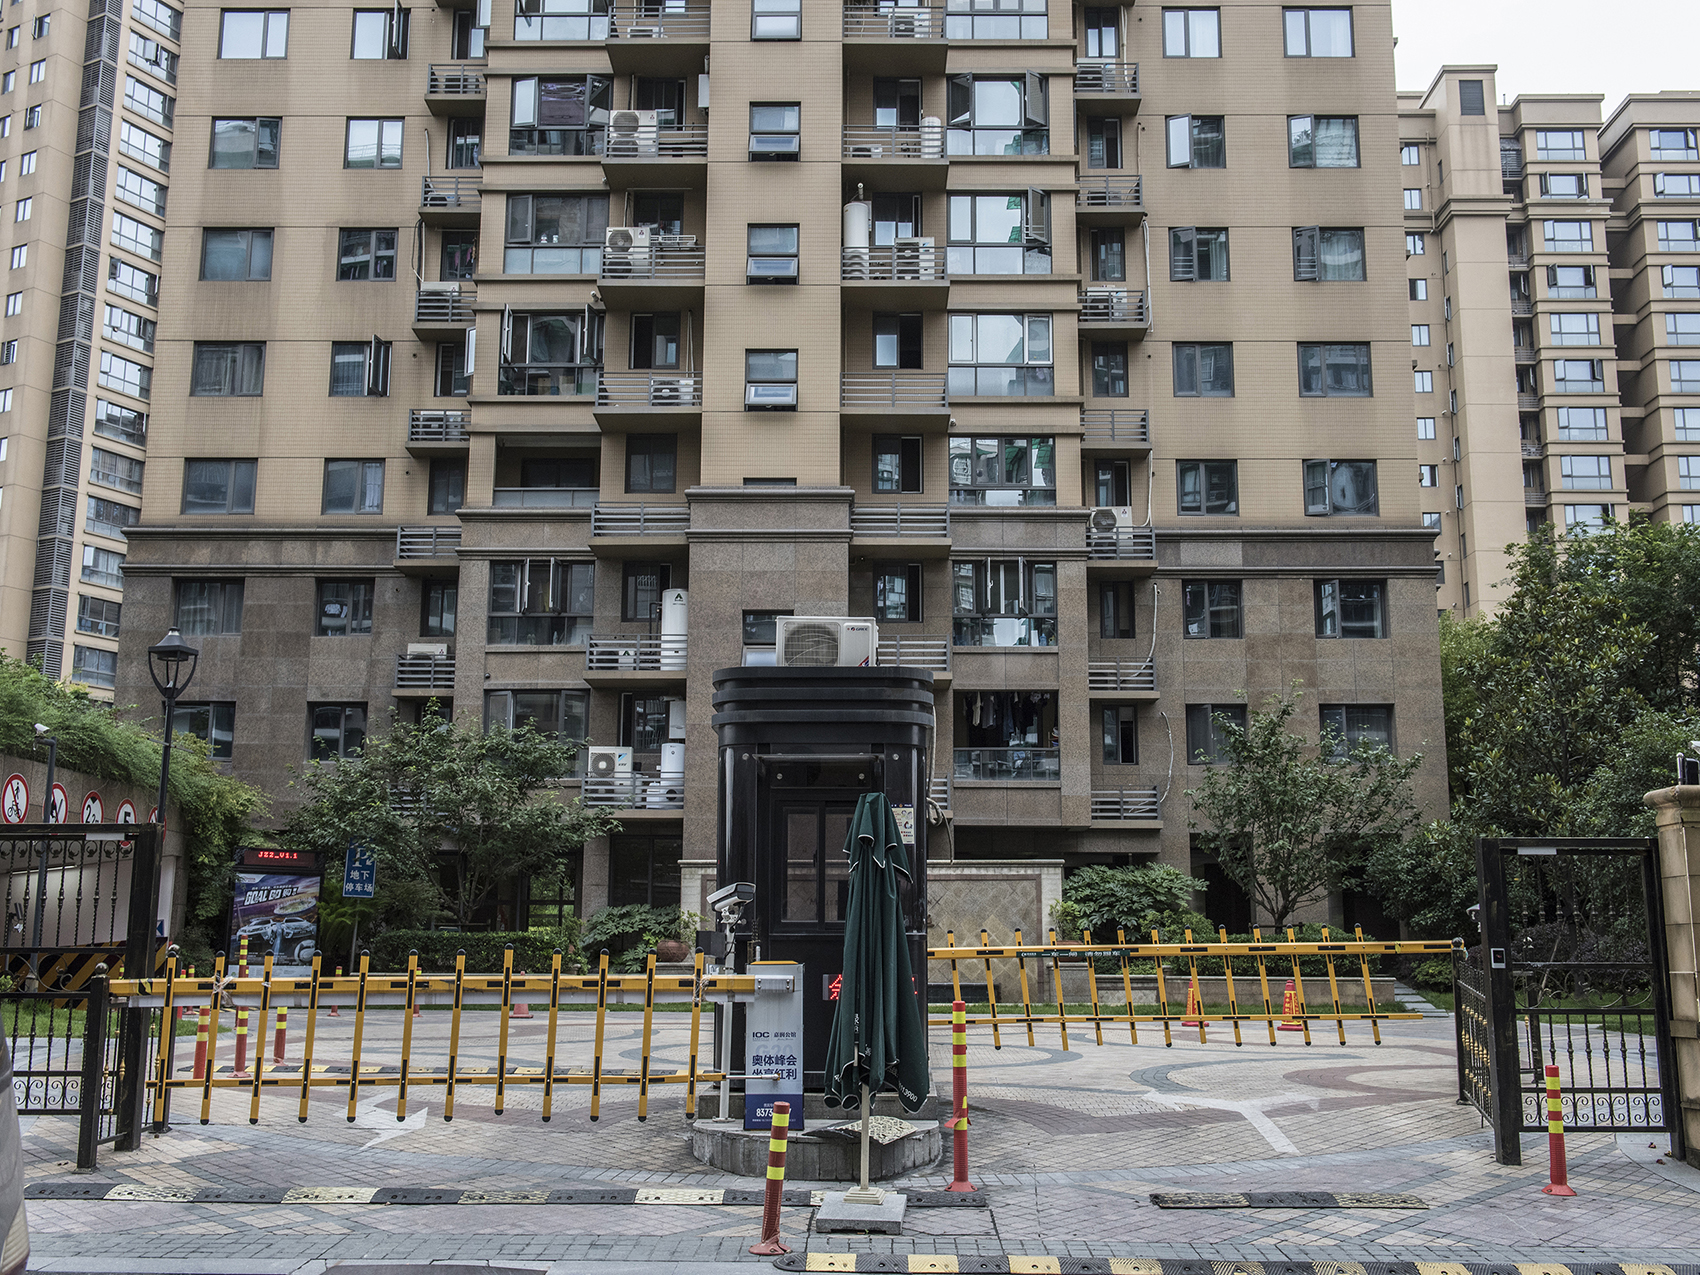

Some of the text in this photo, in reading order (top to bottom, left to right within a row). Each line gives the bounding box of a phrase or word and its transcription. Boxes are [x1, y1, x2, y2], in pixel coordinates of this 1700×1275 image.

[349, 870, 370, 880] 地下
[345, 882, 373, 892] 停车场
[752, 1054, 797, 1066] 奥体峰会
